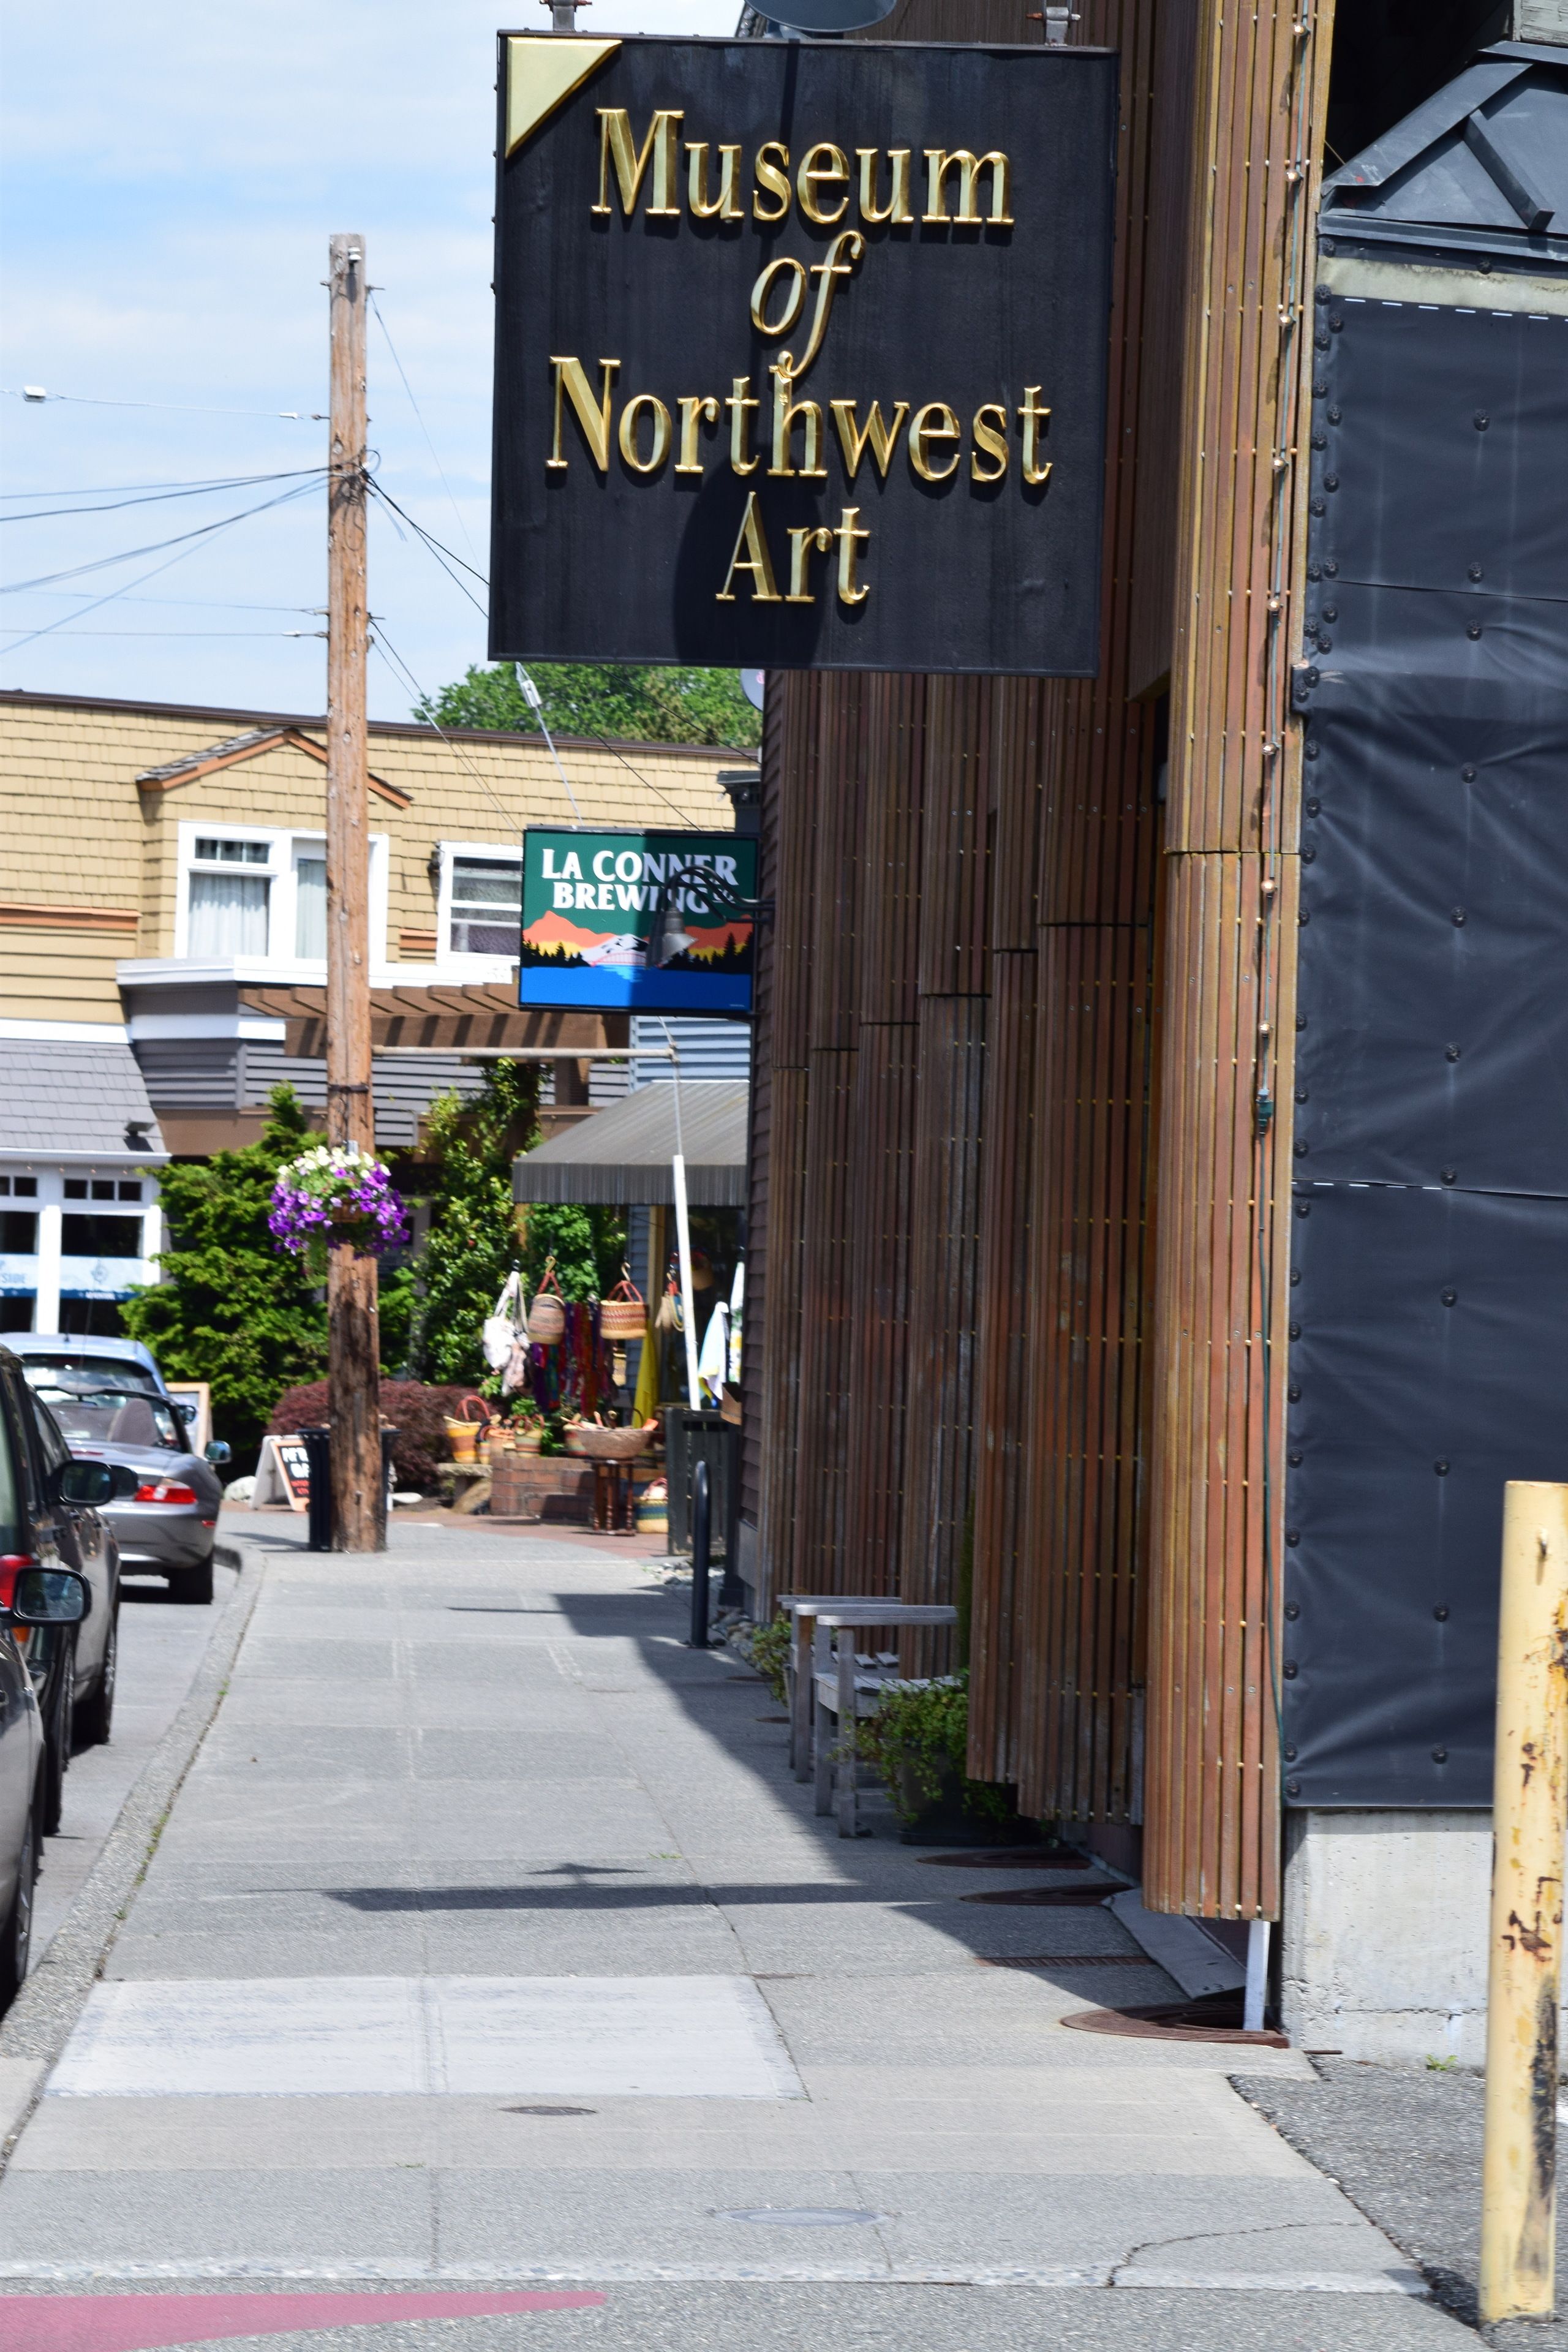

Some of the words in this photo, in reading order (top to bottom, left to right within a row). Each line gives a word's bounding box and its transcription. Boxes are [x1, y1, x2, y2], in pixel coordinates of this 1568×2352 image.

[590, 108, 1014, 225] Museum
[750, 230, 865, 379] of
[546, 355, 1053, 484] Northwest
[715, 491, 870, 605] Art
[541, 848, 584, 880] LA
[592, 850, 739, 886] CONNER
[552, 881, 709, 914] BREWING
